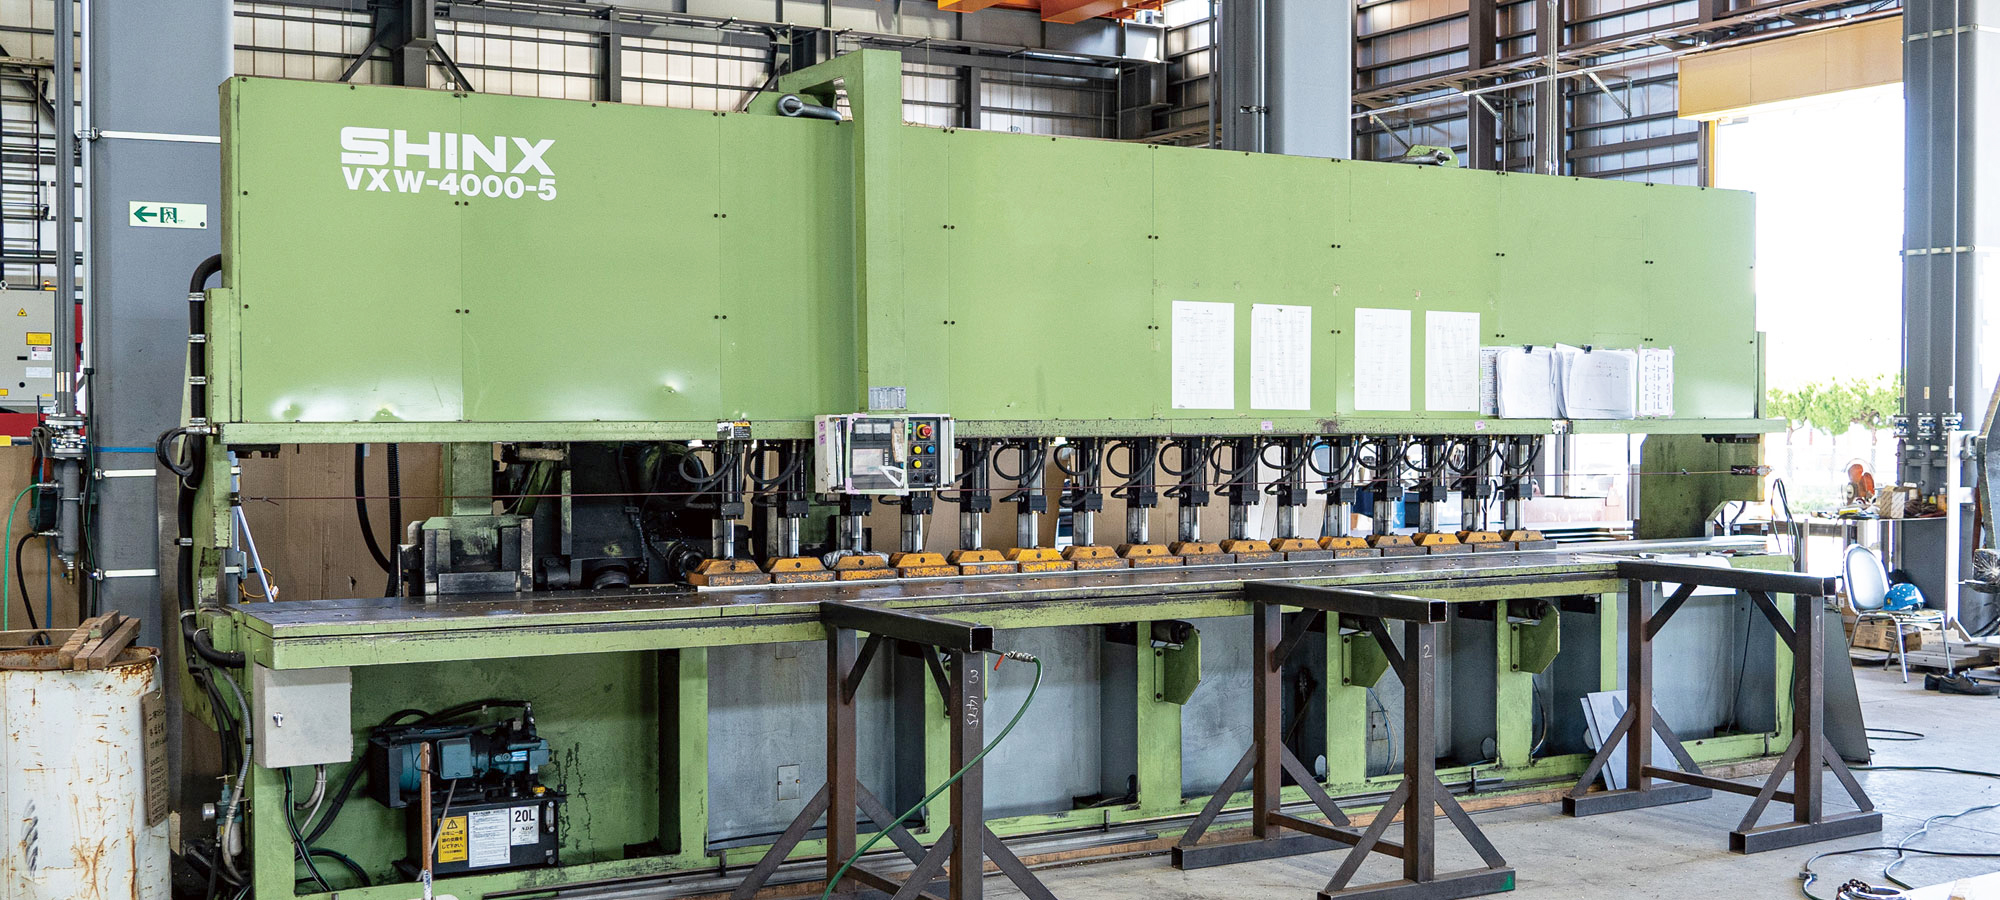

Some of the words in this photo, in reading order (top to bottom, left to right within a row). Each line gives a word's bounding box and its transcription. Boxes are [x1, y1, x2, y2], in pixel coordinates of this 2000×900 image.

[341, 126, 556, 176] SHINX
[342, 167, 557, 201] VXW-4000-5
[1423, 644, 1433, 659] 2
[969, 669, 979, 684] 3
[515, 809, 535, 822] 20L
